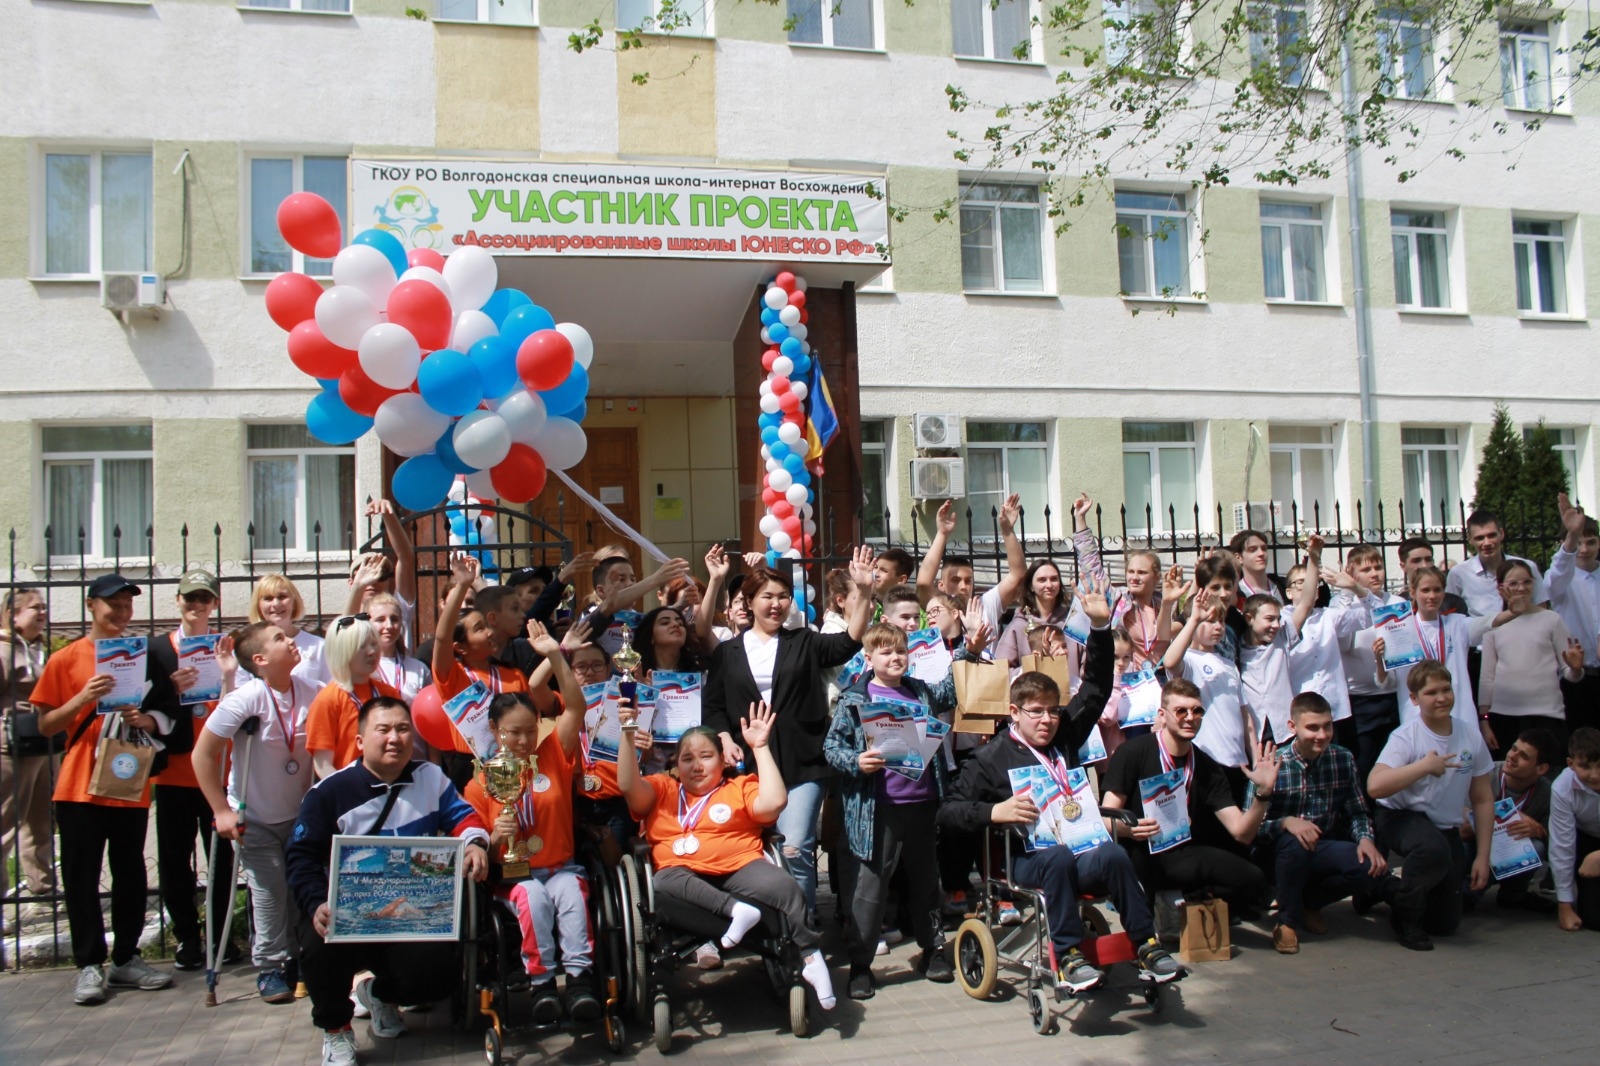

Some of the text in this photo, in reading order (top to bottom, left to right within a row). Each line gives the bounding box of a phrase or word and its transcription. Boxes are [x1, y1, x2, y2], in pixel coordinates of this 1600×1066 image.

[372, 167, 872, 195] ГКОУ РО Волгодонская специальная школа-интернат Восхождени
[467, 189, 859, 232] УЧАСТНИК ПРОЕКТА
[452, 230, 875, 257] «Ассоциированные школы ЮНЕСКО РФ»
